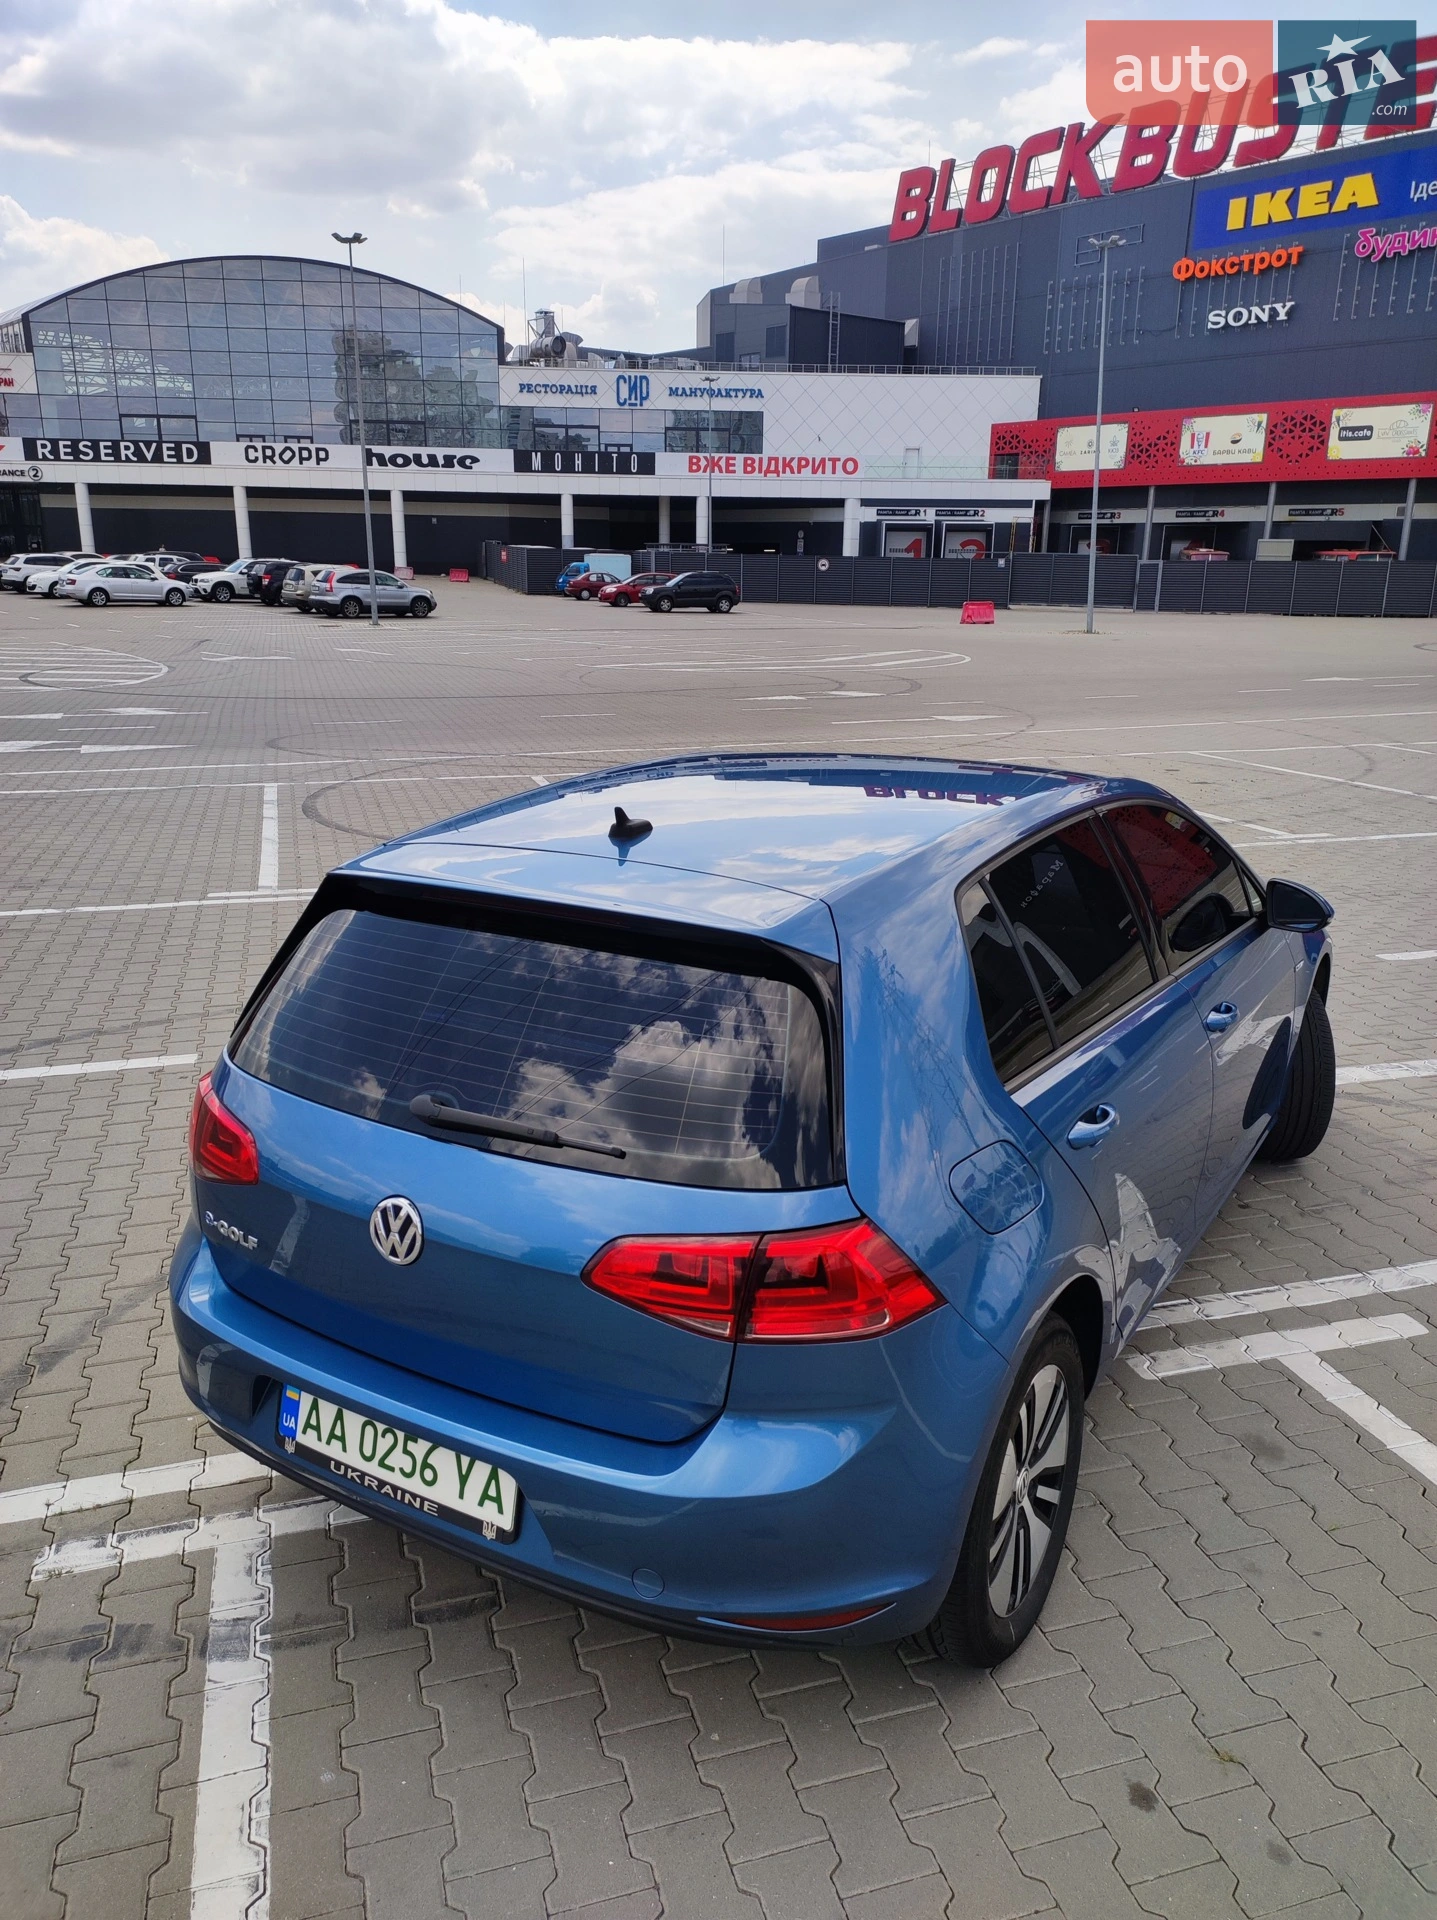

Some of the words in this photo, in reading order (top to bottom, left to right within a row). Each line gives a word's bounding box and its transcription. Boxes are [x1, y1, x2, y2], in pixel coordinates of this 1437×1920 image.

[1226, 172, 1379, 231] IKEA
[1172, 245, 1305, 281] Фокстрот
[1207, 301, 1295, 329] SONY
[518, 383, 598, 397] РЕСТОРАЦІЯ
[616, 374, 650, 407] СИР
[668, 386, 764, 399] МАНУФАКТУРА
[1340, 428, 1371, 438] itis.cafe
[36, 439, 199, 463] RESERVED
[244, 444, 330, 466] CROPP
[365, 448, 480, 470] house
[688, 455, 736, 475] ВЖЕ
[743, 456, 859, 477] ВІДКРИТО
[283, 1412, 296, 1431] UA
[301, 1396, 347, 1454] AA
[358, 1419, 441, 1487] 0256
[455, 1452, 504, 1516] YA
[330, 1460, 439, 1517] UKRAINE
